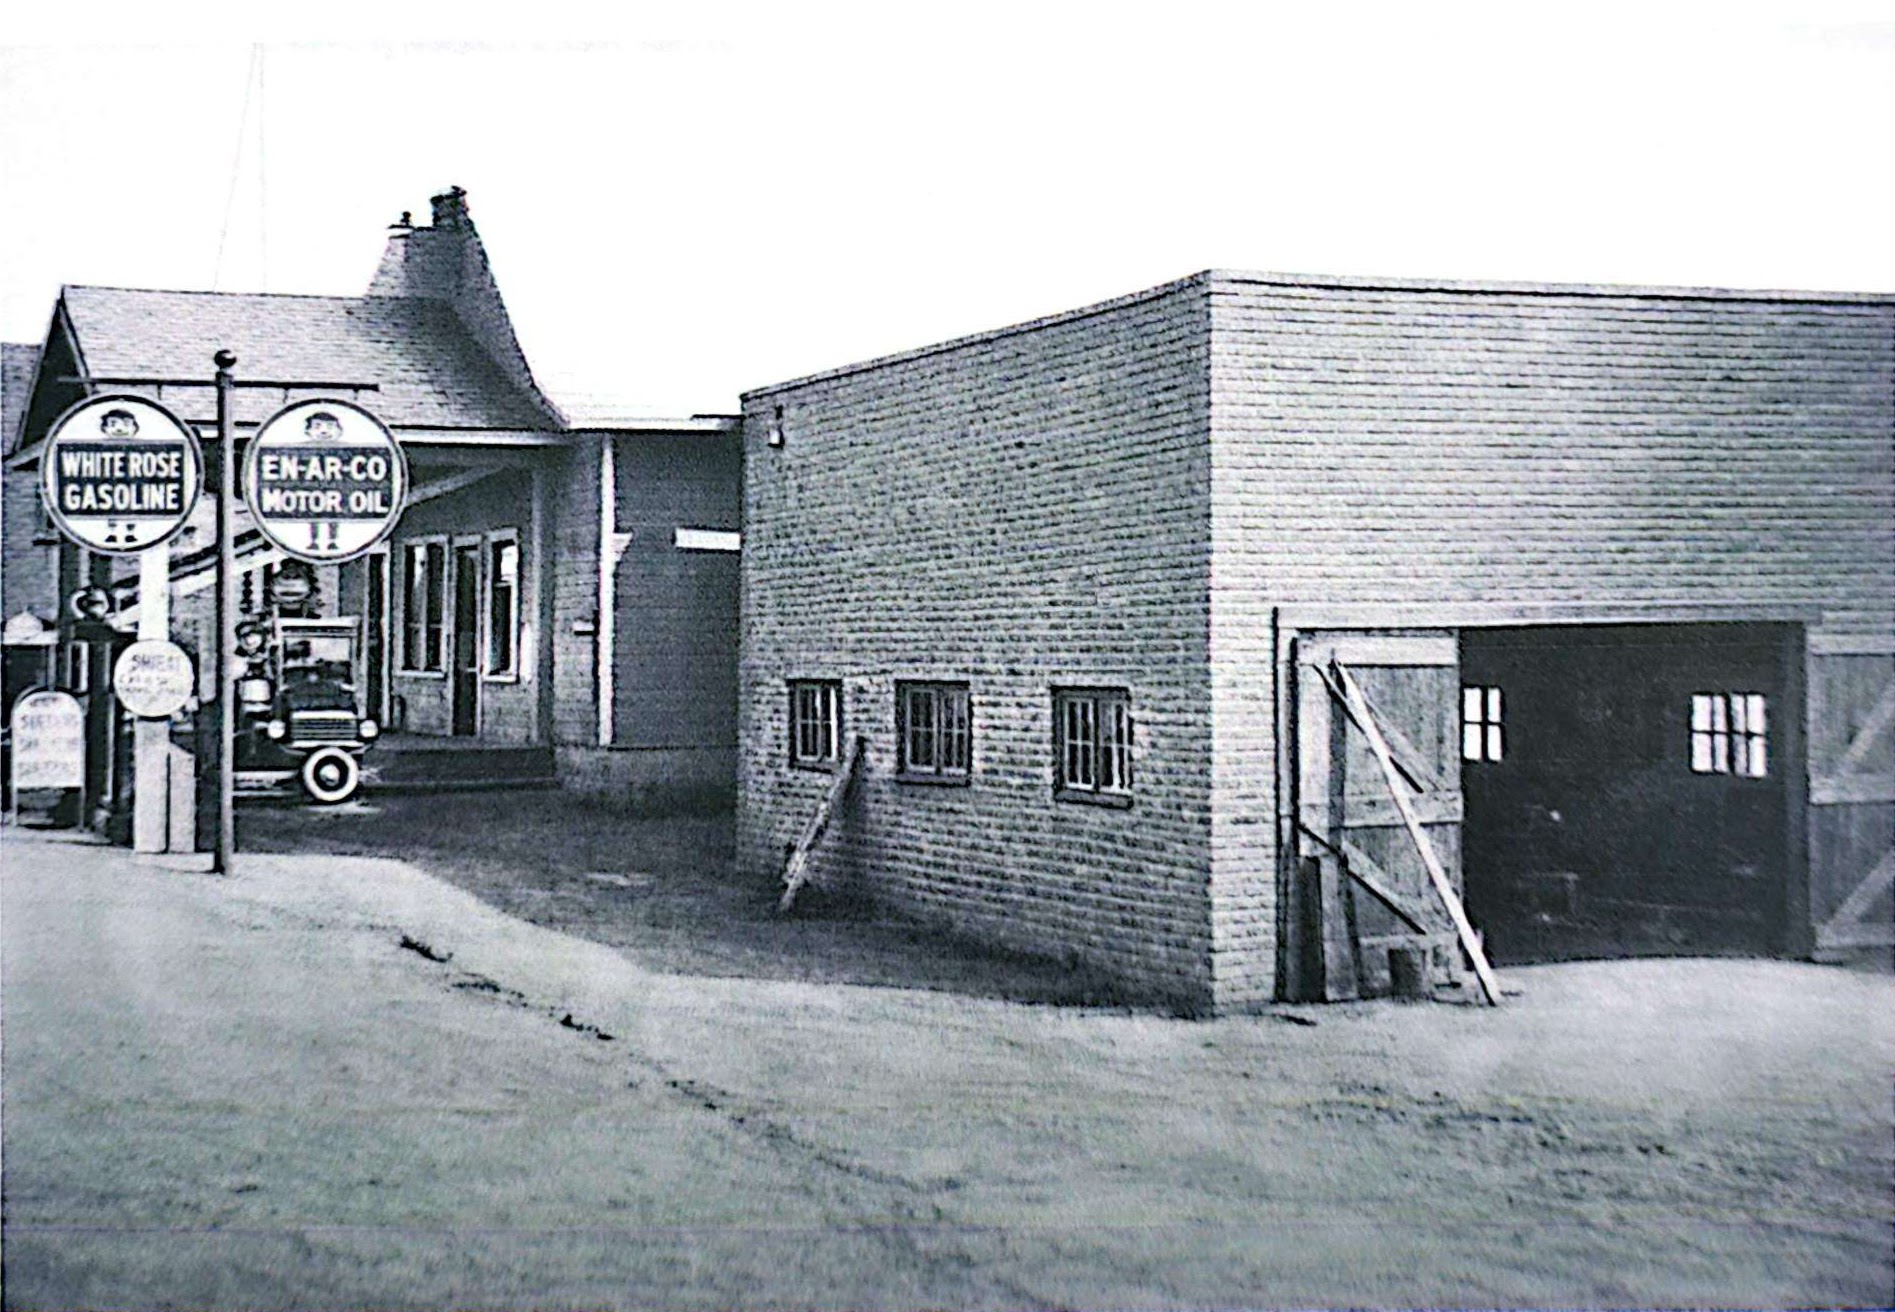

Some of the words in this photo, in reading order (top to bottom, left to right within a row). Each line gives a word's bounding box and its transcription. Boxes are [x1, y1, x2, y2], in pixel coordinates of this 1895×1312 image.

[61, 451, 126, 478] WHITE
[128, 451, 181, 478] ROSE
[261, 455, 387, 481] EN-AR-CO
[64, 483, 180, 510] GASOLINE
[262, 488, 342, 512] MOTOR
[349, 490, 389, 513] OIL
